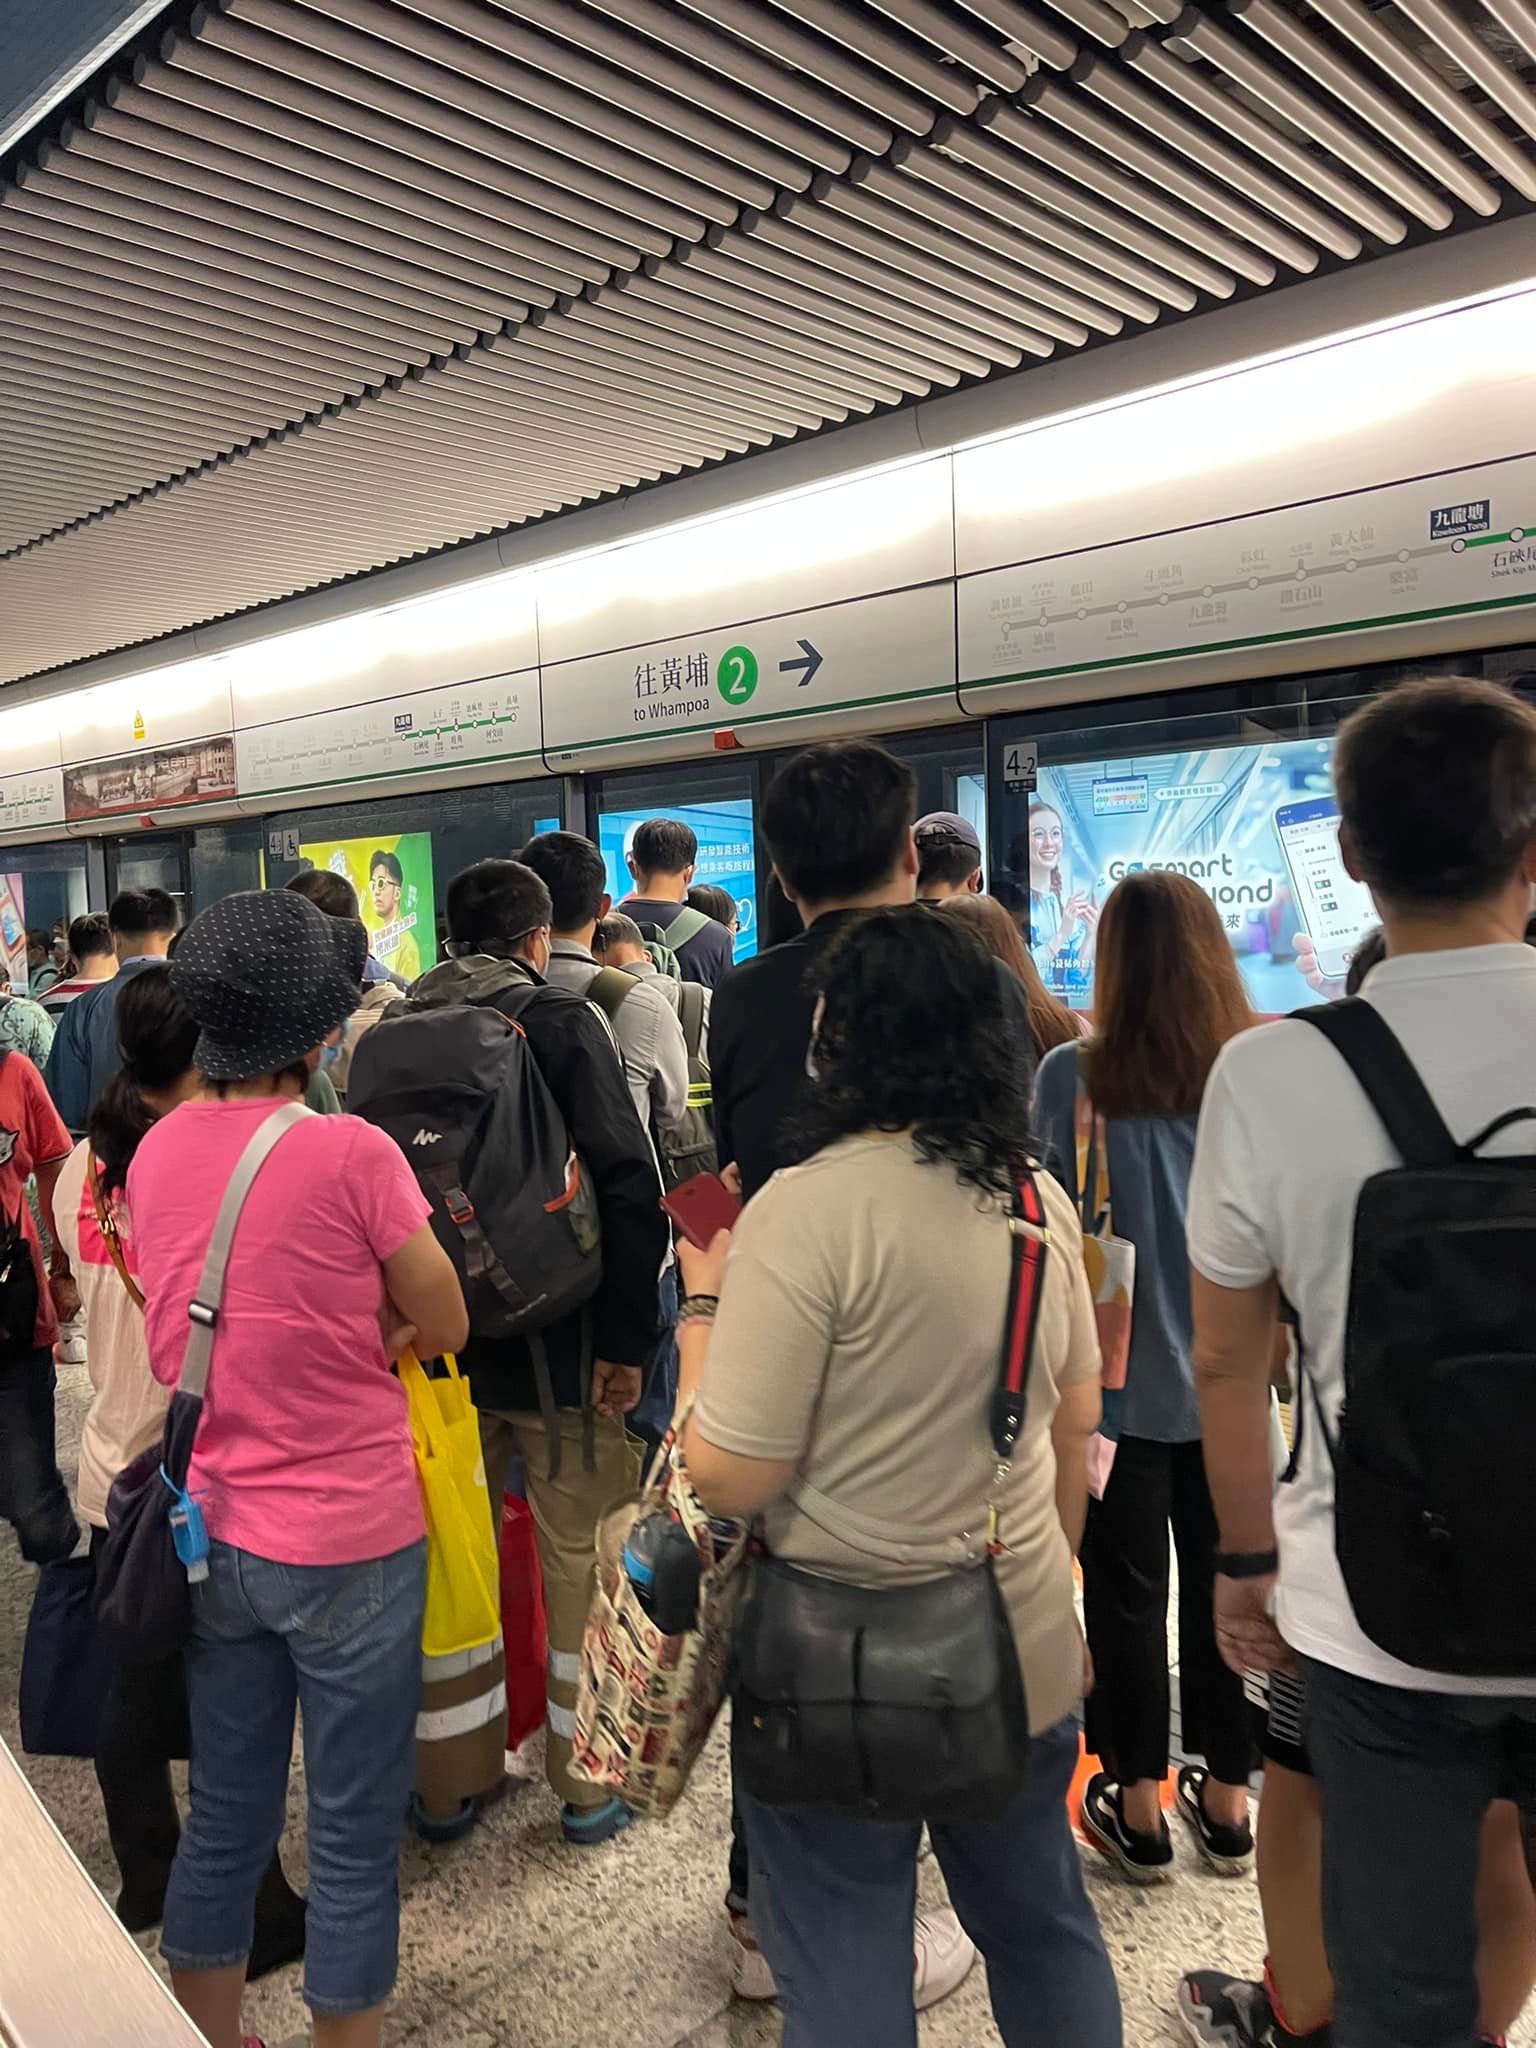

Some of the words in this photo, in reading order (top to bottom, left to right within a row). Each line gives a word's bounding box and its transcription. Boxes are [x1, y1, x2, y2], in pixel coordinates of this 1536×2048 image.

[634, 652, 708, 698] 往黃埔
[729, 656, 746, 695] 2
[634, 709, 646, 721] to
[648, 698, 710, 718] Whampoa
[1006, 750, 1036, 776] 4-2
